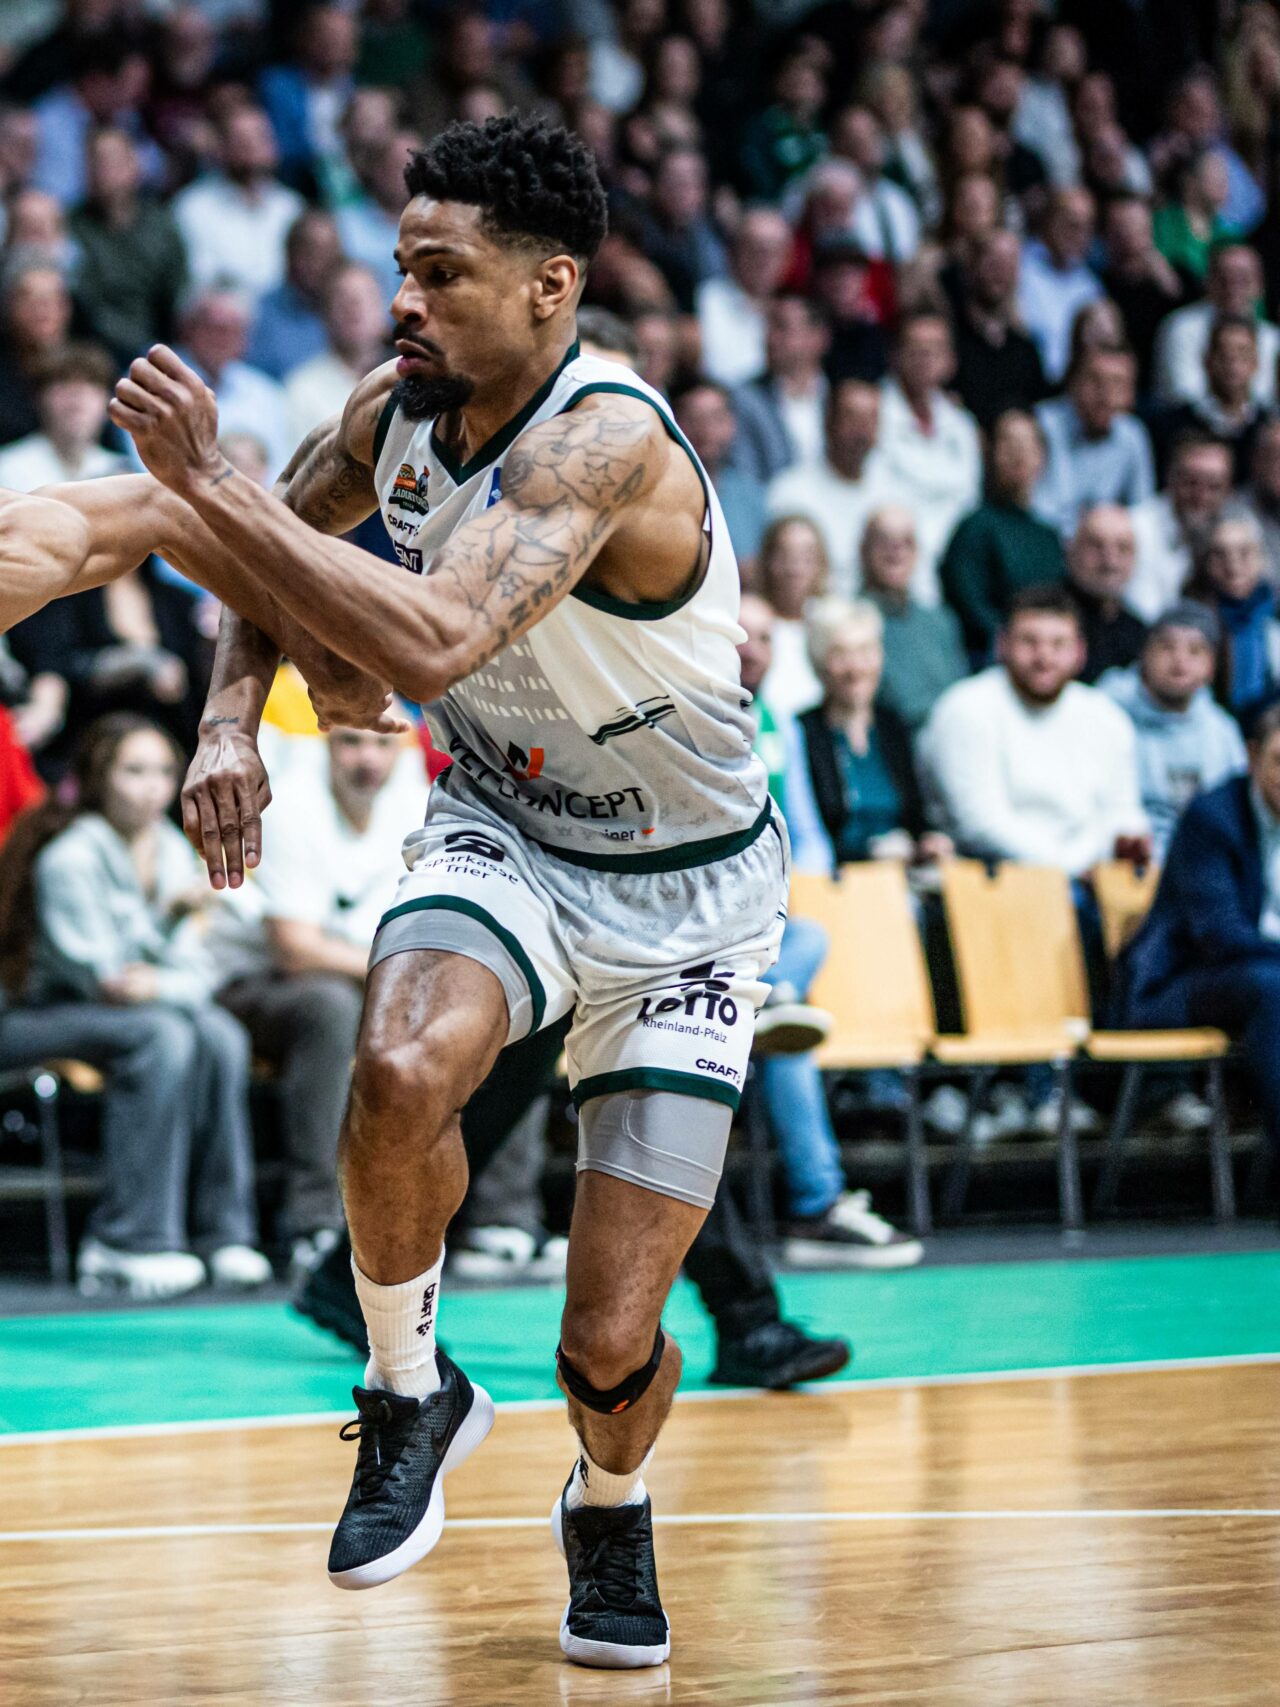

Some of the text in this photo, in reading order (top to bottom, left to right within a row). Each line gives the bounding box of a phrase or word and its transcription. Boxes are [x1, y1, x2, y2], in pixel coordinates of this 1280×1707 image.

[387, 514, 416, 535] CRAFT
[447, 865, 491, 879] Trier
[637, 991, 738, 1026] LOTTO
[642, 1017, 728, 1043] Rheinland-Pfalz
[695, 1058, 739, 1081] CRAFT
